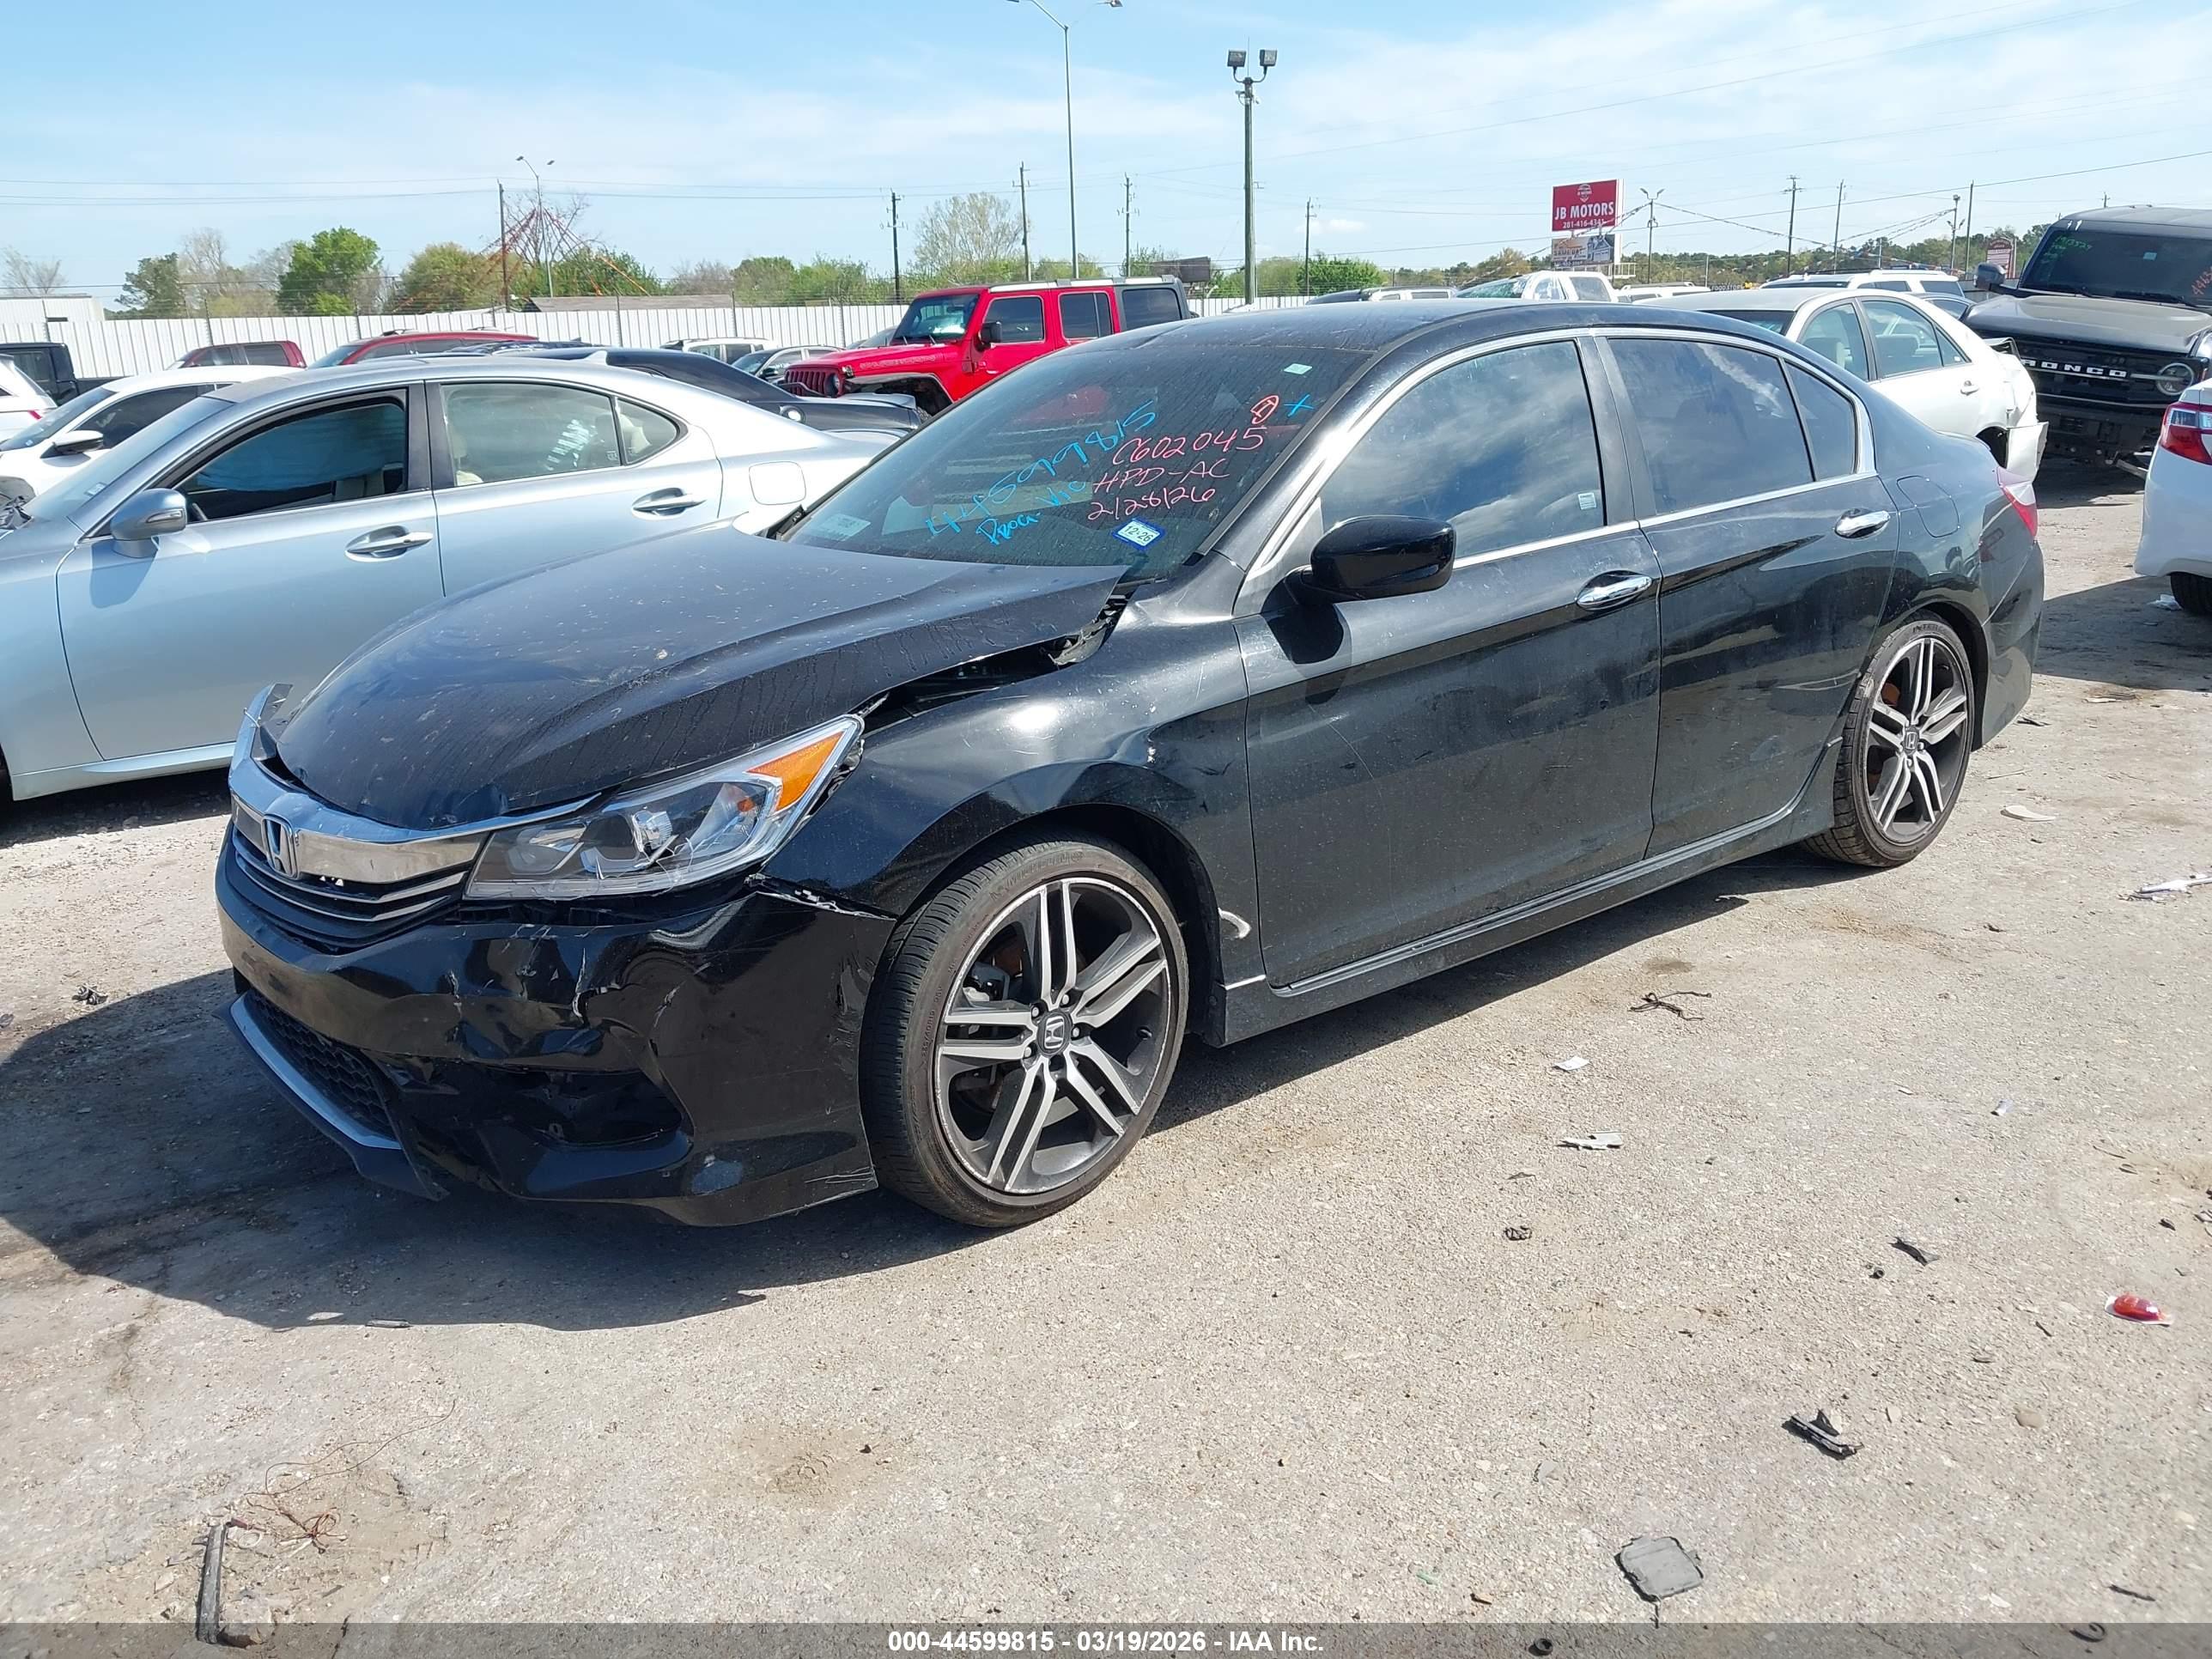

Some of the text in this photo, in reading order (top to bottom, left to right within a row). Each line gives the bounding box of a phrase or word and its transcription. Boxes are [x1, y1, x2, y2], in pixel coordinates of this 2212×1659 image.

[1554, 201, 1614, 221] JB MOTORS
[2021, 358, 2127, 379] RONCO
[1092, 458, 1231, 494] HPD-AC
